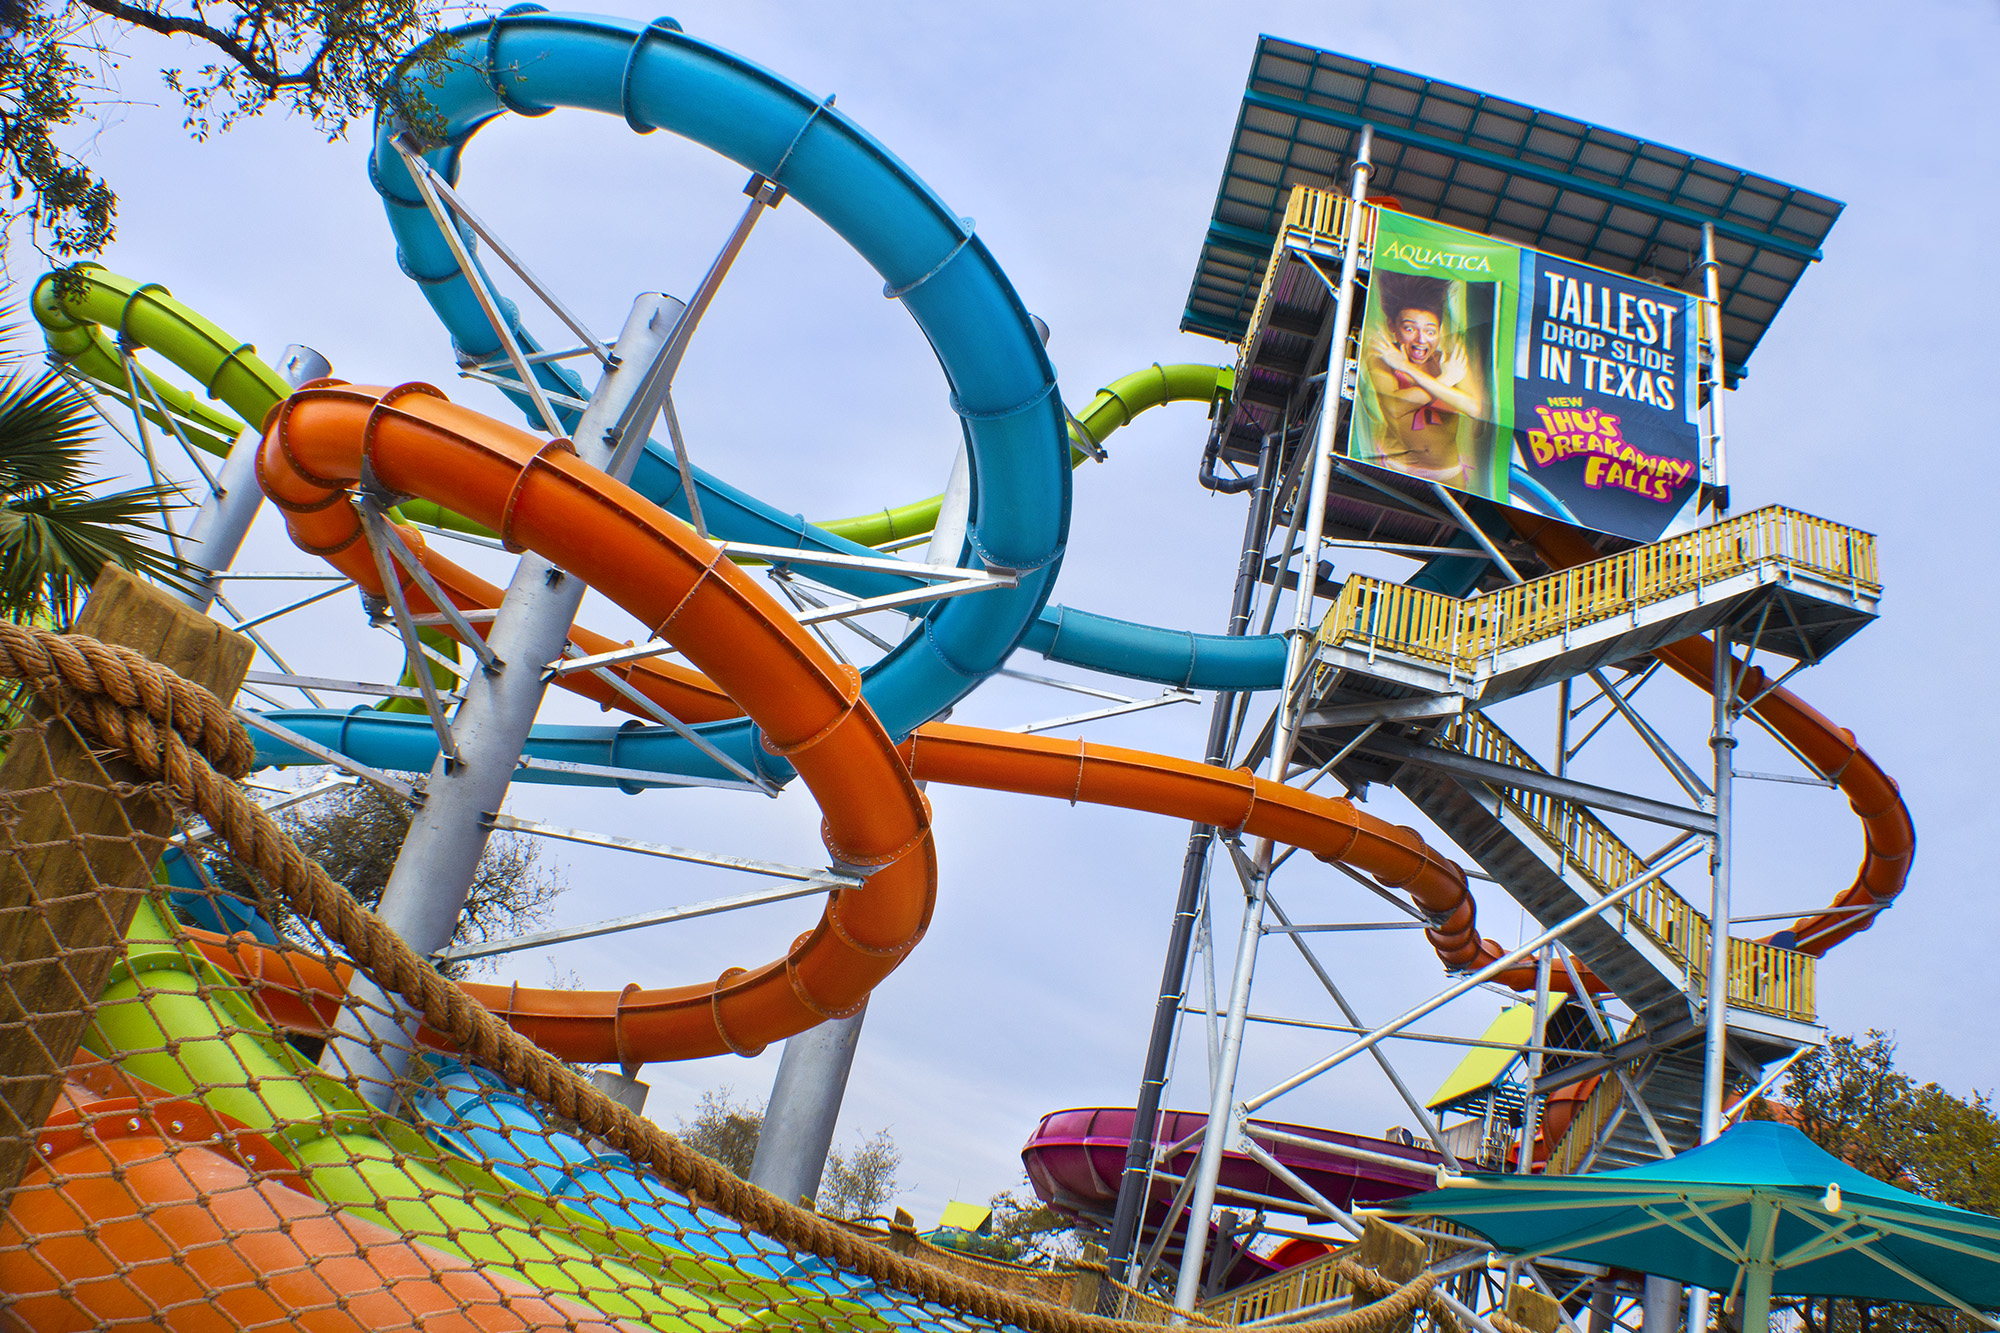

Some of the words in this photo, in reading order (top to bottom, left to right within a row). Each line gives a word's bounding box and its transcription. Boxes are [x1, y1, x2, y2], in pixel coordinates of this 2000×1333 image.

[1381, 240, 1492, 273] AQUATICA
[1544, 271, 1678, 351] TALLEST
[1542, 321, 1607, 353] DROP
[1610, 340, 1675, 375] SLIDE
[1540, 344, 1571, 385] IN
[1580, 354, 1675, 411] TEXAS
[1547, 396, 1583, 408] NEW
[1528, 430, 1692, 483] BREAKAWAY
[1585, 456, 1671, 500] FALLS
